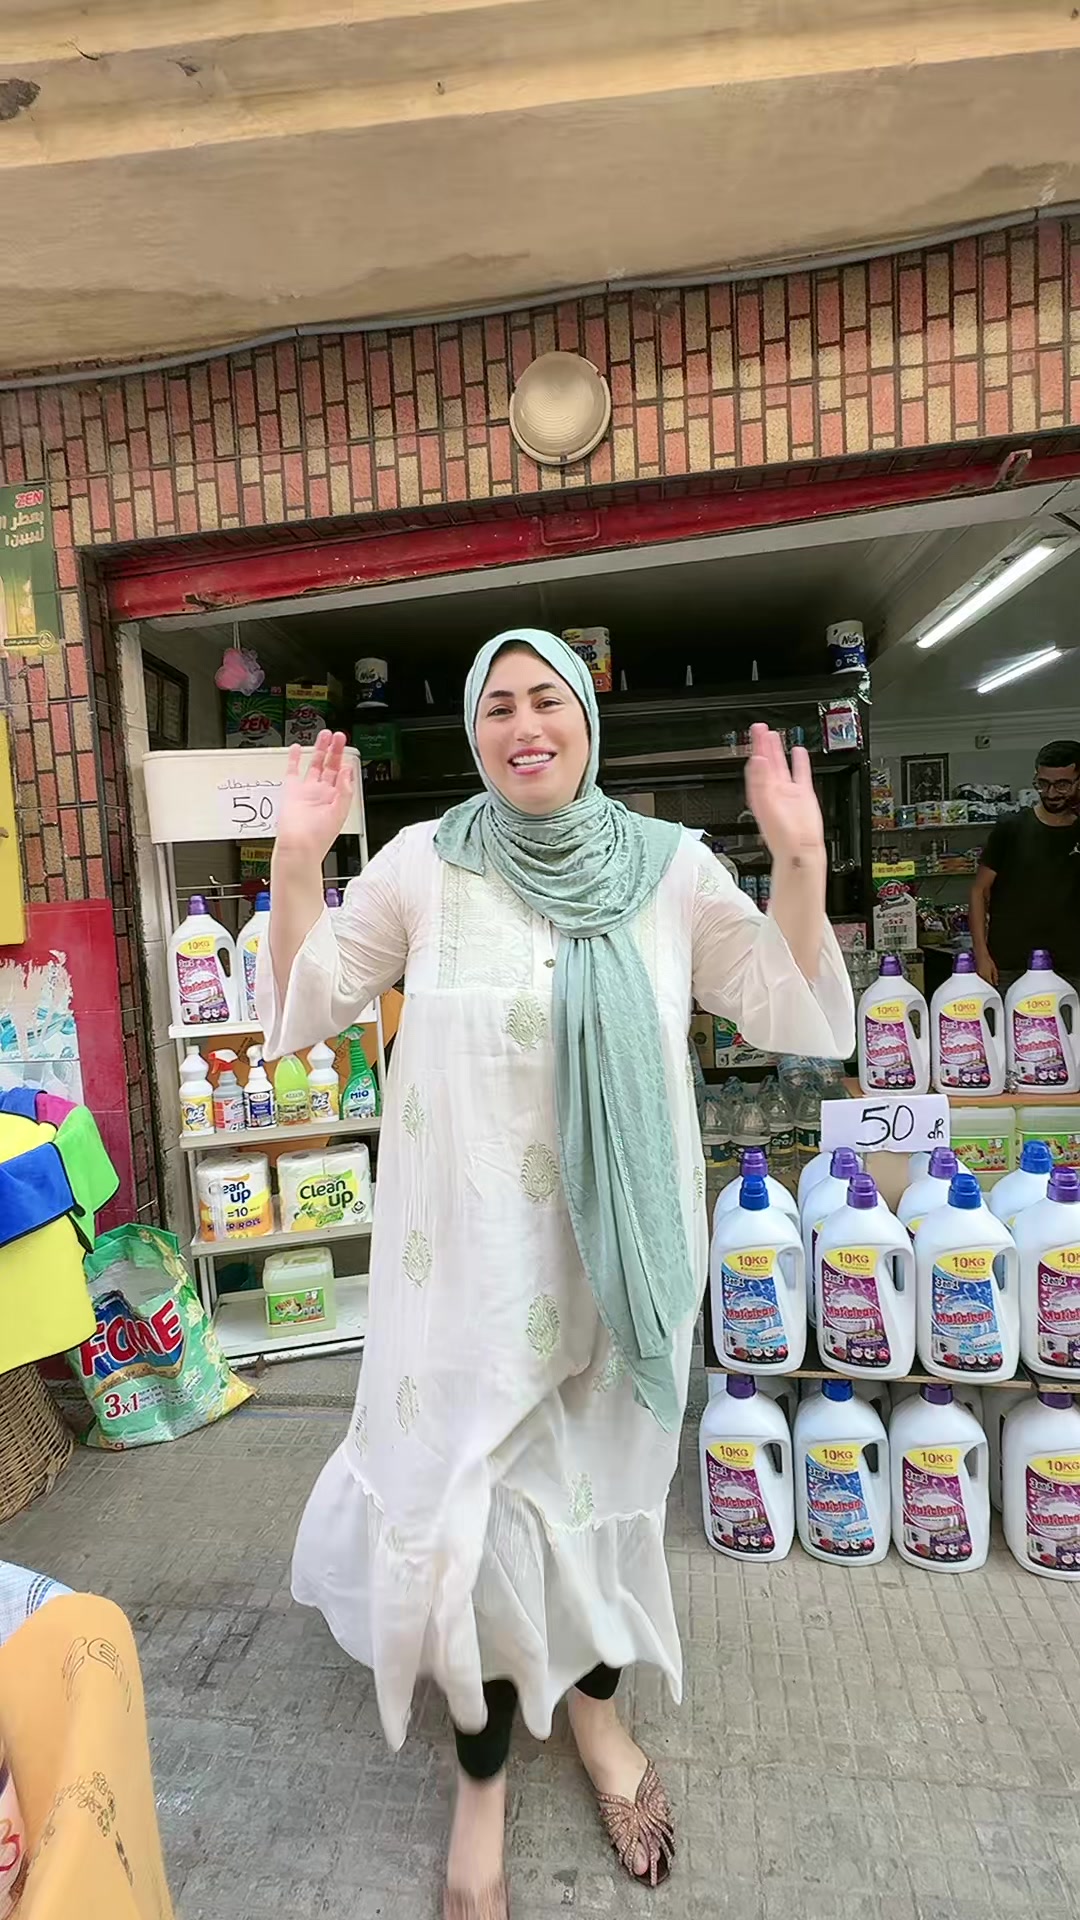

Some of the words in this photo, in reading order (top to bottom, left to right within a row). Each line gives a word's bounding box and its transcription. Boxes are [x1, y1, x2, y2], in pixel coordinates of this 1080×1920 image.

[14, 489, 44, 509] ZEN
[240, 713, 270, 731] ZEN
[231, 796, 273, 823] 50
[856, 1105, 914, 1146] 50
[230, 1189, 251, 1203] up
[299, 1180, 347, 1200] Clean
[328, 1190, 354, 1208] up
[737, 1255, 769, 1267] 10KG
[837, 1252, 870, 1264] 10KG
[952, 1256, 986, 1269] 10KG
[104, 1393, 140, 1419] 3x1
[720, 1445, 749, 1457] 10KG
[822, 1448, 853, 1460] 10KG
[921, 1451, 953, 1464] 10KG
